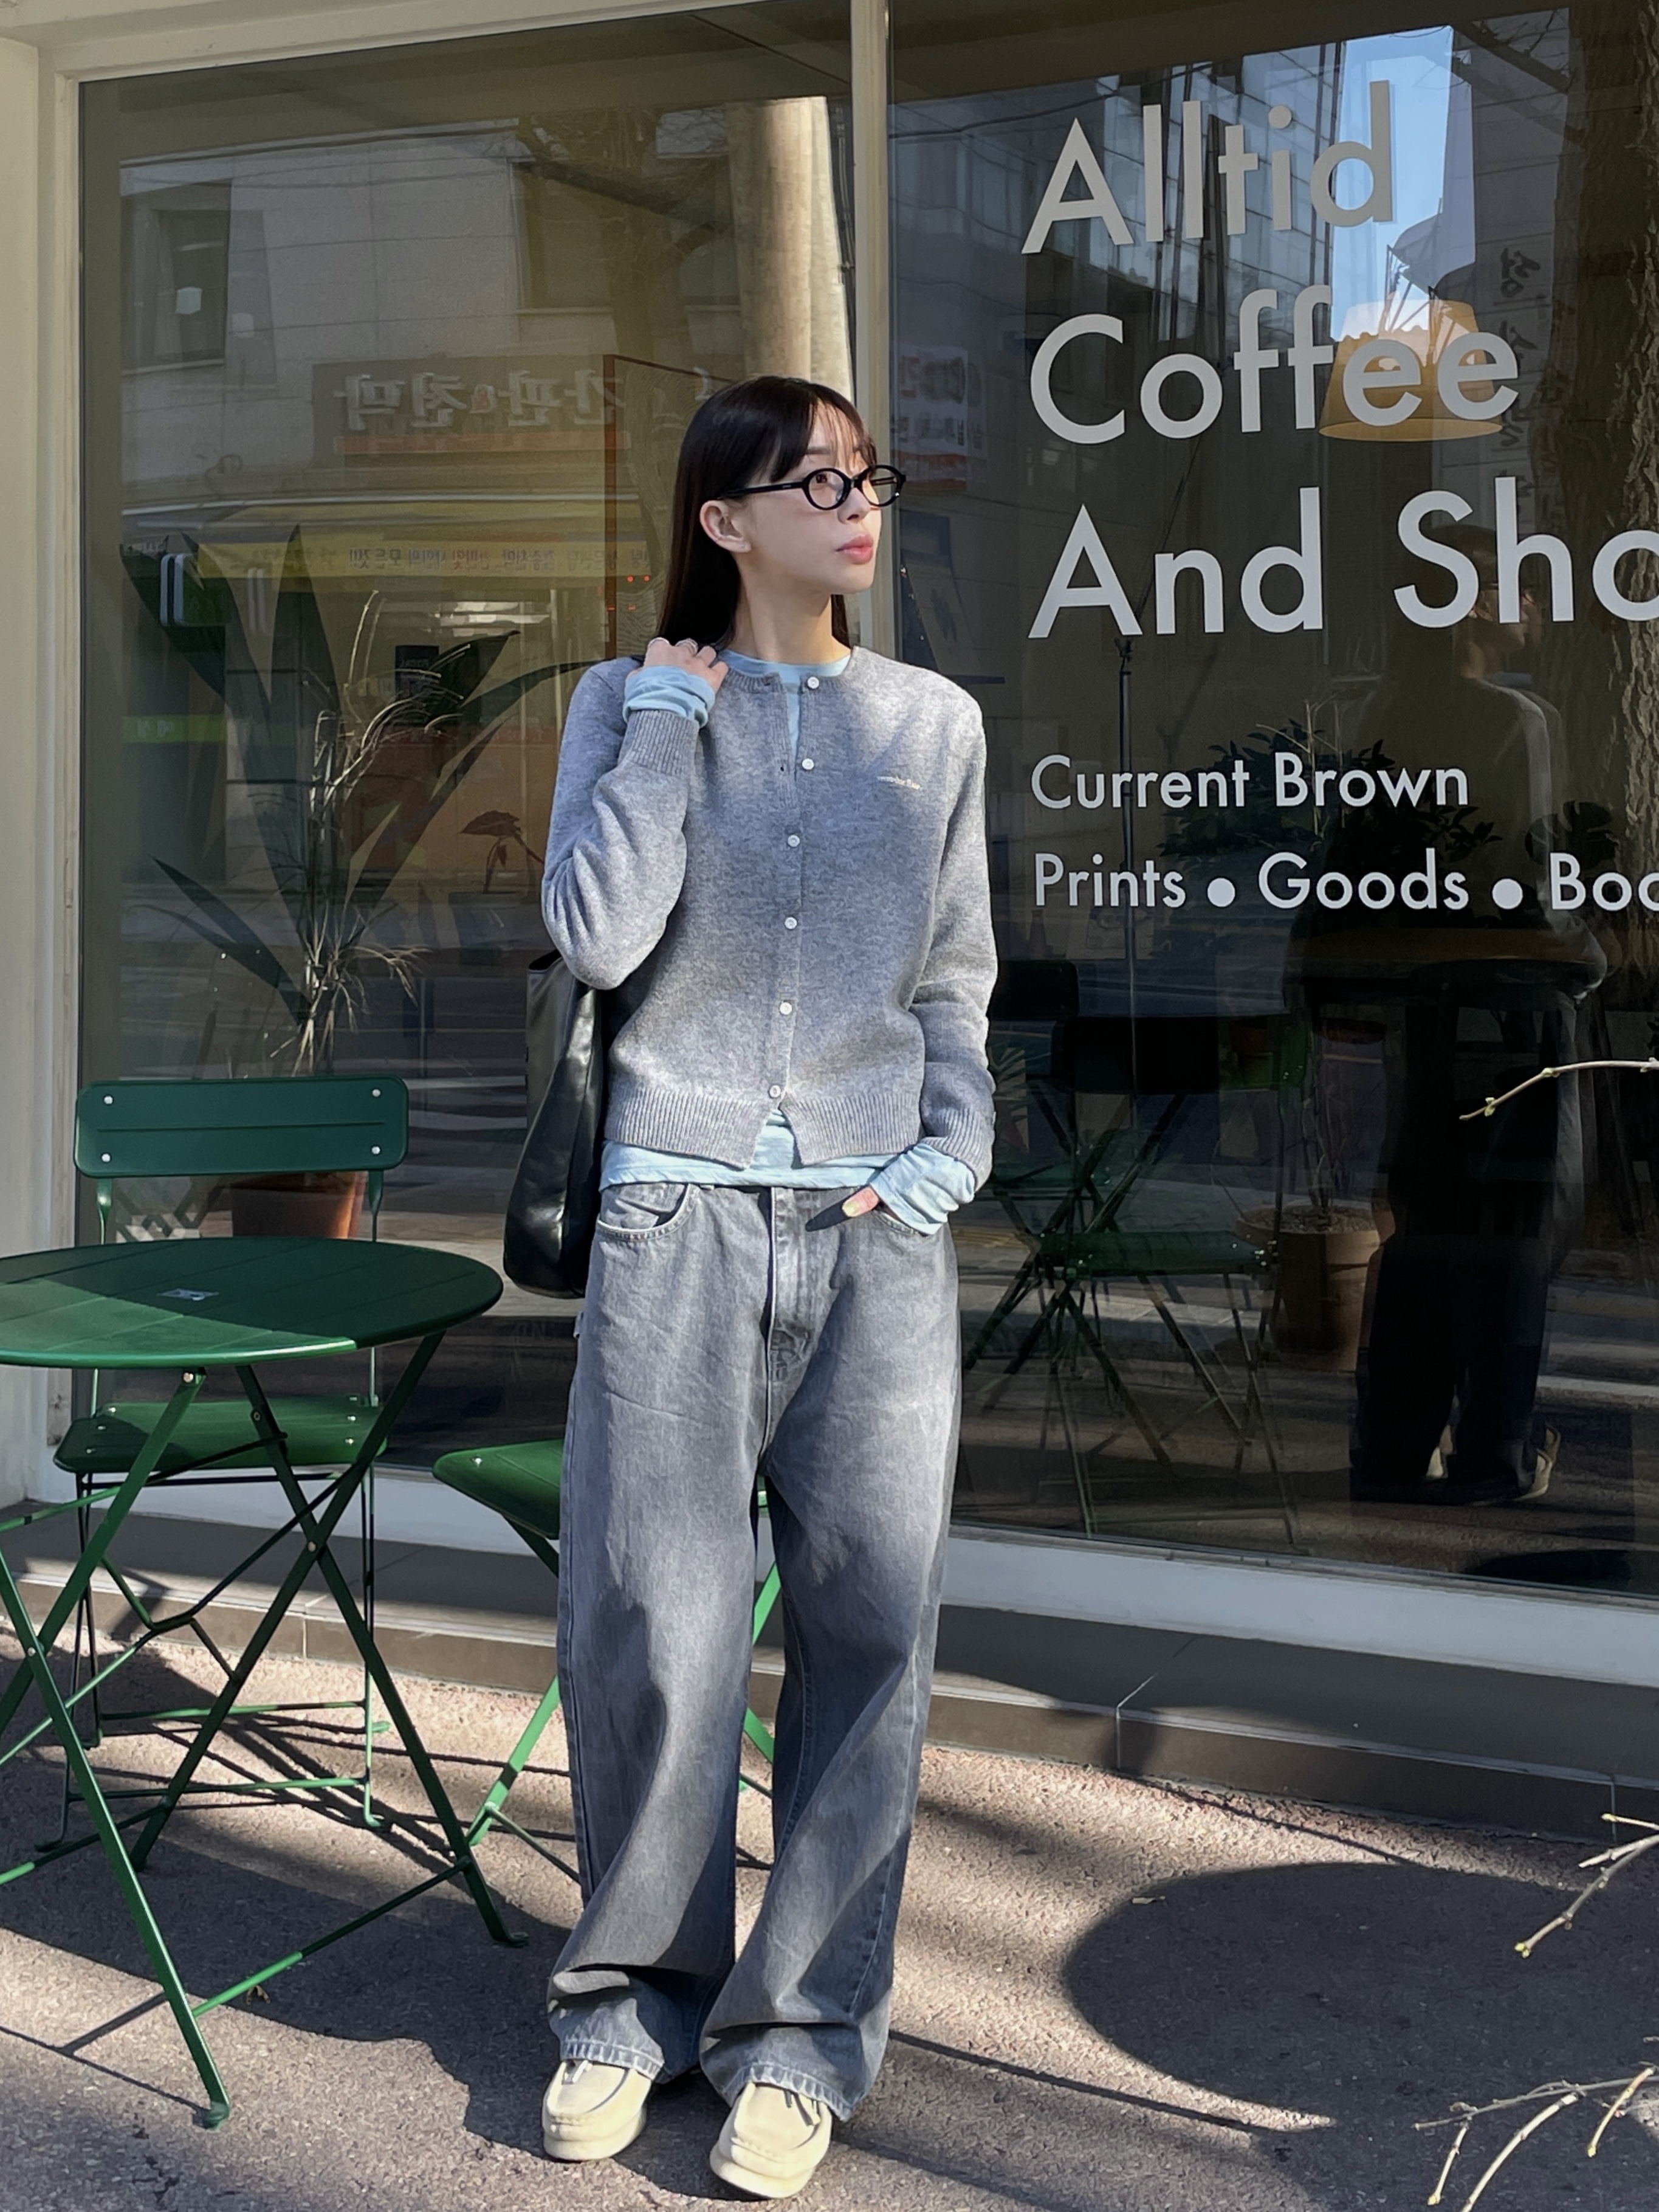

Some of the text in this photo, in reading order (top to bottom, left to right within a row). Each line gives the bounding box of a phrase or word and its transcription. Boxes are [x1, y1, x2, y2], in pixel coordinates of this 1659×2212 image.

[1021, 80, 1393, 255] Alltid
[1030, 284, 1519, 444] Coffee
[1028, 477, 1659, 638] And Sho
[1031, 751, 1468, 808] Current Brown
[1035, 853, 1186, 908] Prints
[1259, 848, 1469, 909] Goods
